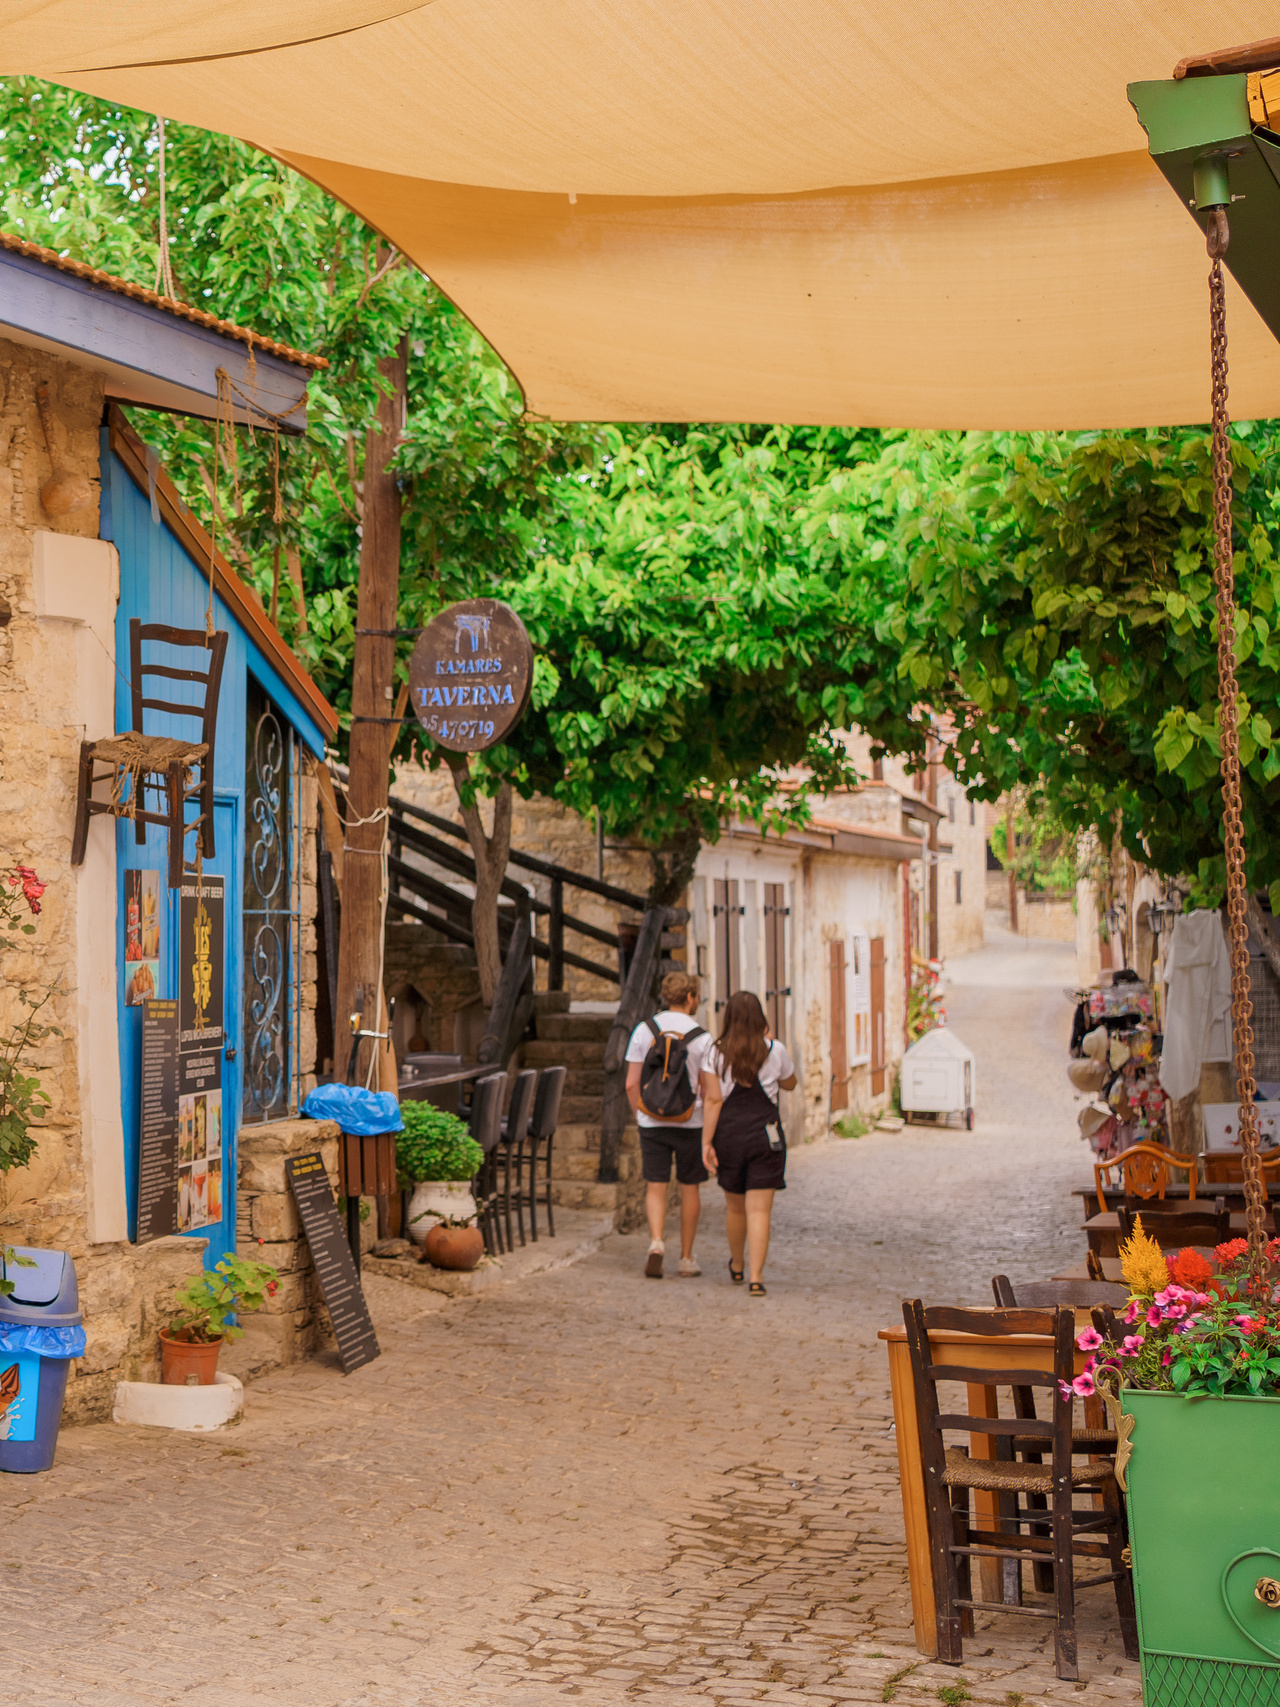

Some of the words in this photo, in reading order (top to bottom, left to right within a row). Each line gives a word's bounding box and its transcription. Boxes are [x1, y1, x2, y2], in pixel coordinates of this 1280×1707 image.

[436, 657, 503, 675] KAMARES
[417, 684, 516, 708] TAVERNA
[196, 885, 210, 898] CAFT
